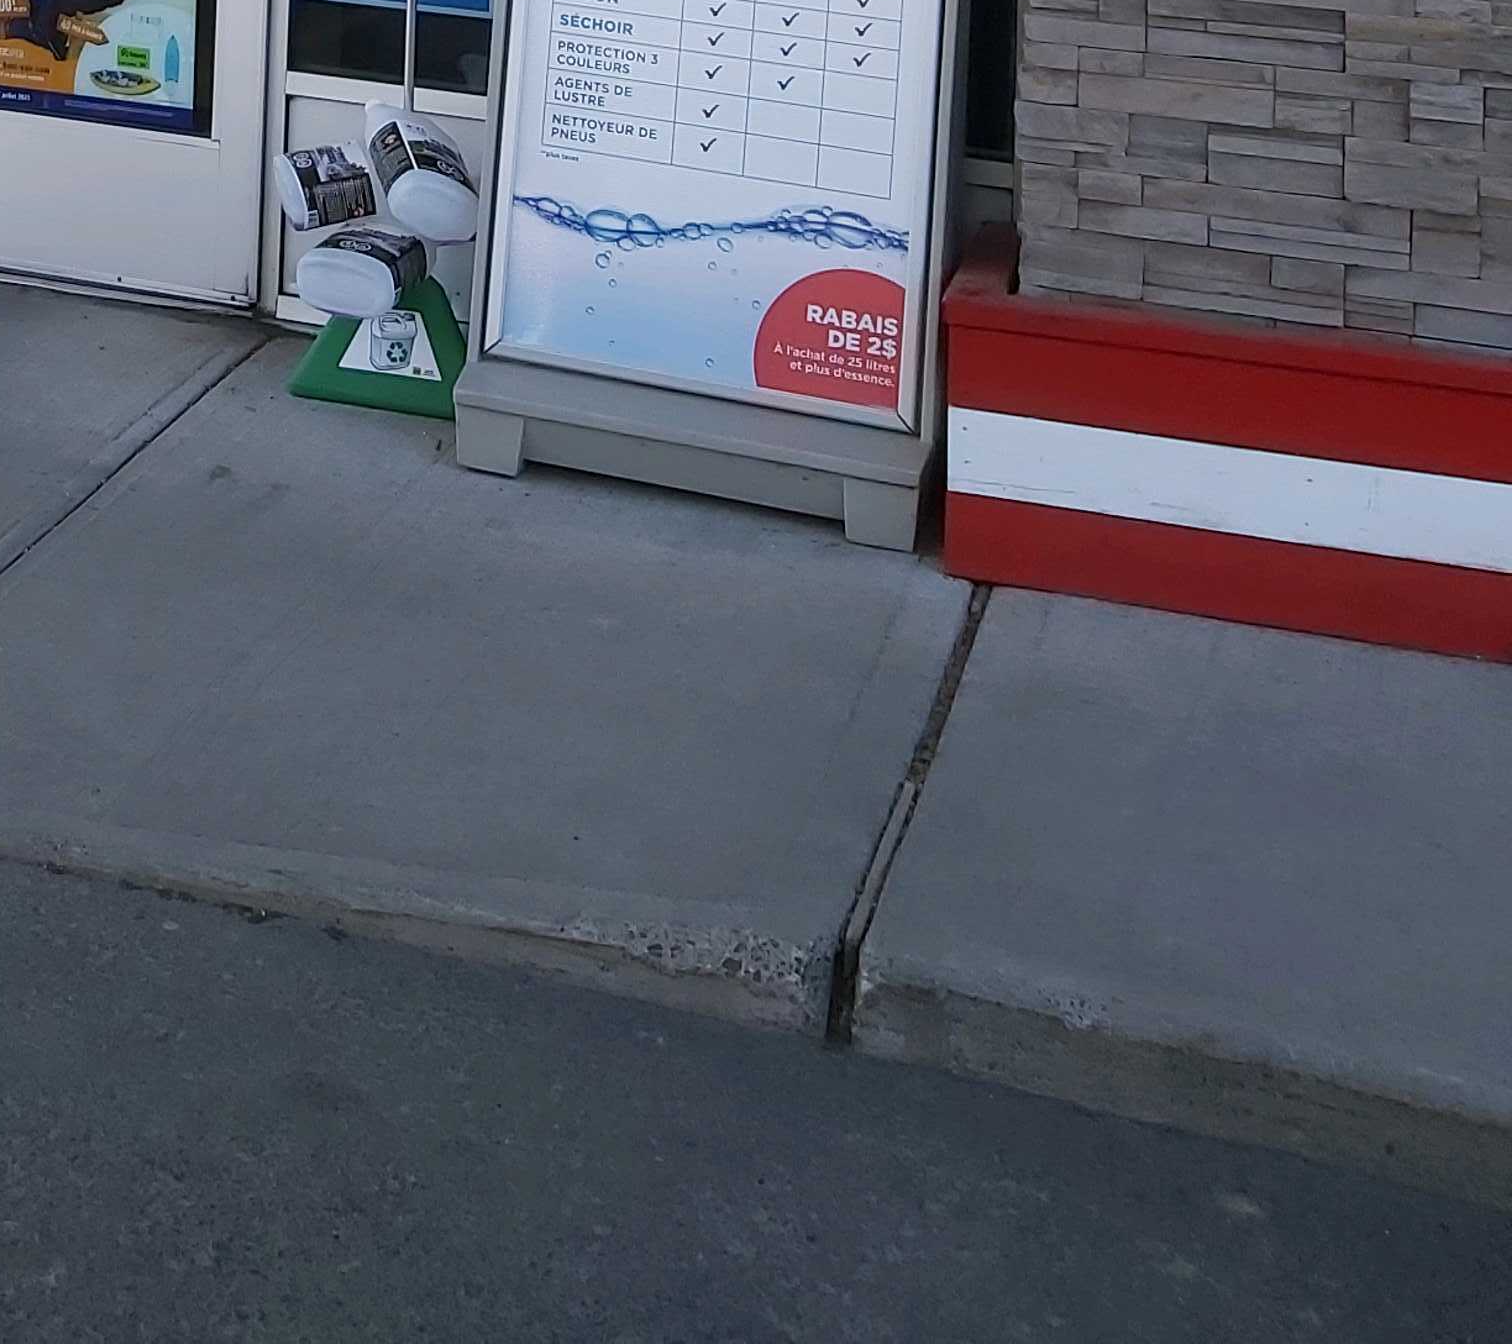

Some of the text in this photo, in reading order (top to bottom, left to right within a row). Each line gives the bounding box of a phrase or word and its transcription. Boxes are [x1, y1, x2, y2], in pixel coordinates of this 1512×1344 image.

[560, 12, 633, 35] SÉCHOIR
[557, 40, 659, 65] PROTECTION 3
[557, 54, 631, 74] COULEURS
[554, 76, 633, 97] AGENTS DE
[554, 89, 606, 107] LUSTRE
[550, 127, 596, 143] PNEUS
[552, 114, 658, 140] NETTOYEUR DE
[806, 304, 898, 336] RABAIS
[828, 329, 897, 360] DE 2$
[787, 344, 825, 362] l'achat
[829, 353, 845, 365] de
[847, 357, 863, 368] 25
[866, 359, 896, 374] litres
[789, 360, 895, 388] et plus d'essence.
